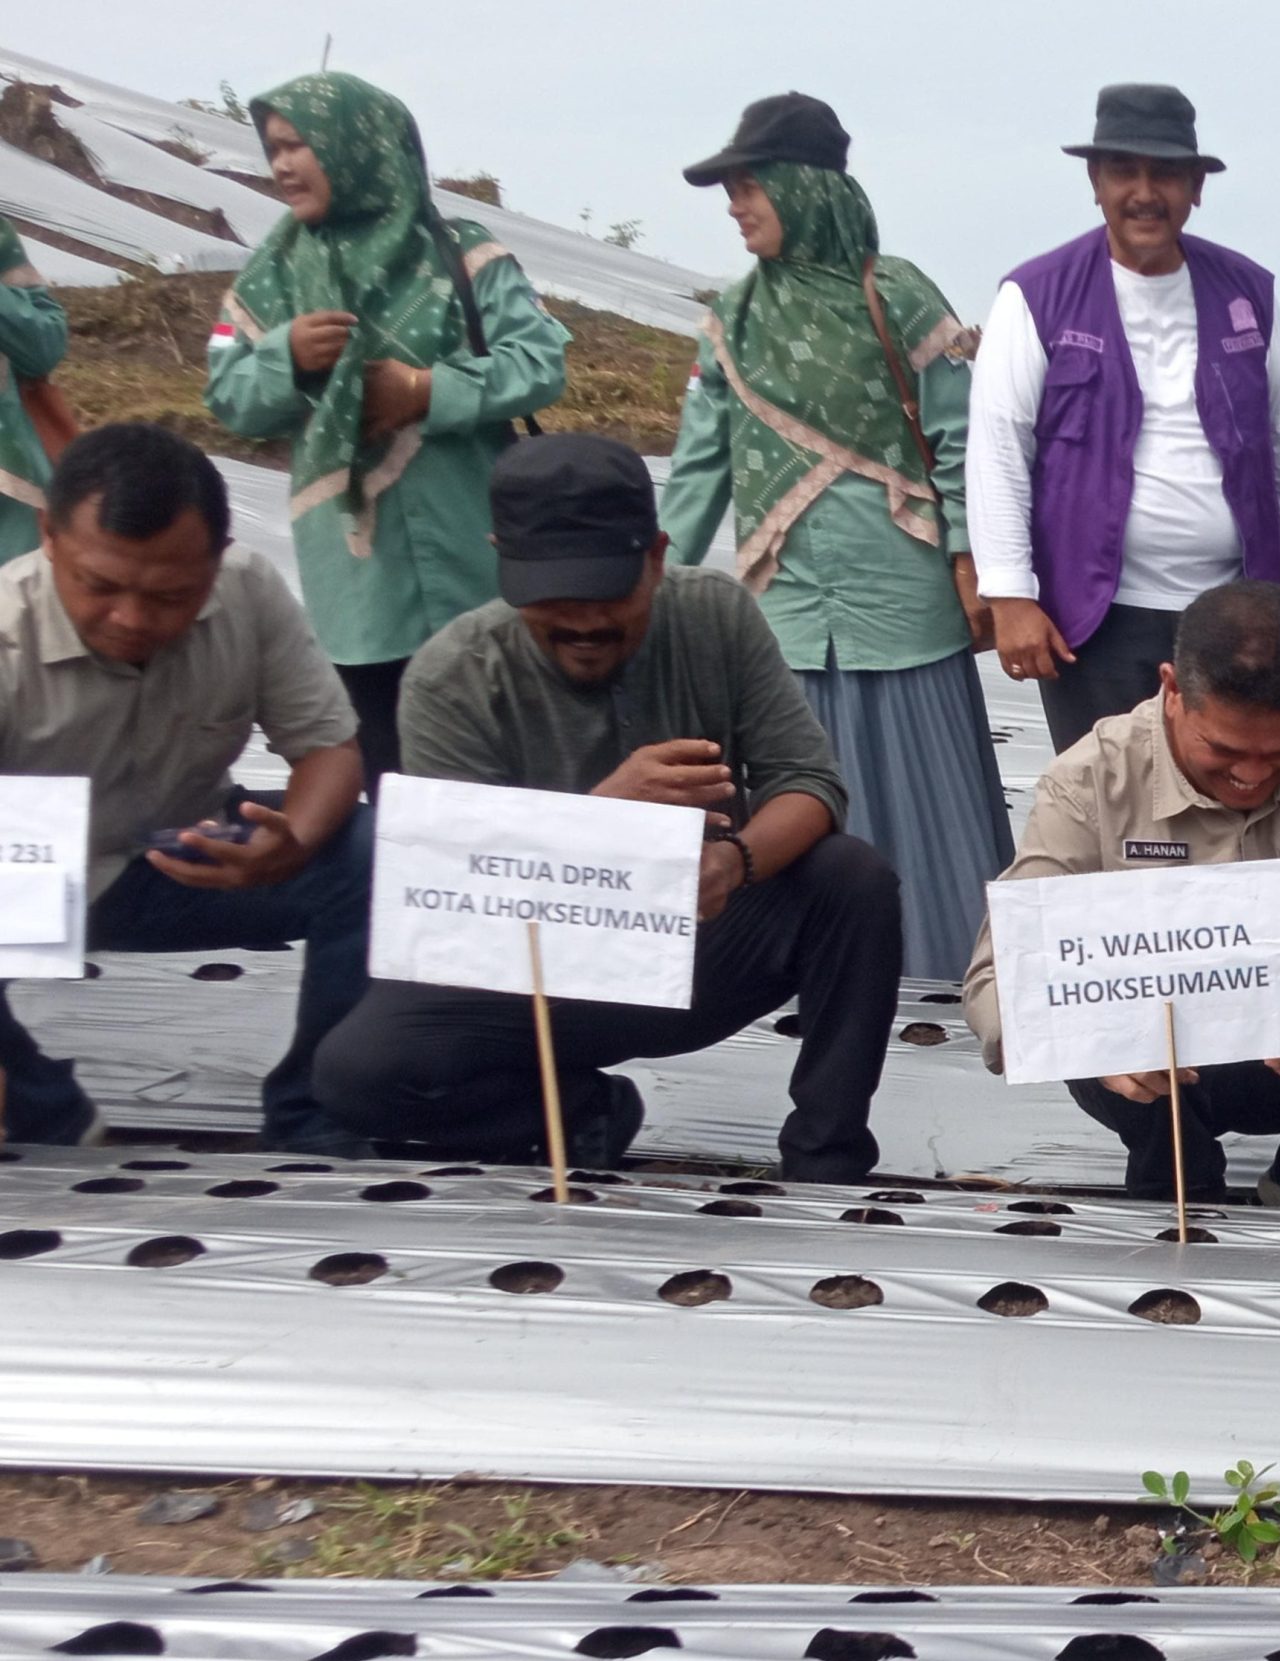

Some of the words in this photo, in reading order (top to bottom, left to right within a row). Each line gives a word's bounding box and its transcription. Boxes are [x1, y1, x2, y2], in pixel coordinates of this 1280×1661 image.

[10, 844, 56, 864] 231
[1144, 844, 1186, 857] HANAN
[468, 853, 556, 883] KETUA
[563, 864, 633, 892] DPRK
[404, 886, 476, 914] KOTA
[483, 895, 692, 937] LHOKSEUMAWE
[1059, 937, 1094, 967] Pj.
[1101, 923, 1253, 958] WALIKOTA
[1046, 964, 1271, 1007] LHOKSEUMAWE
